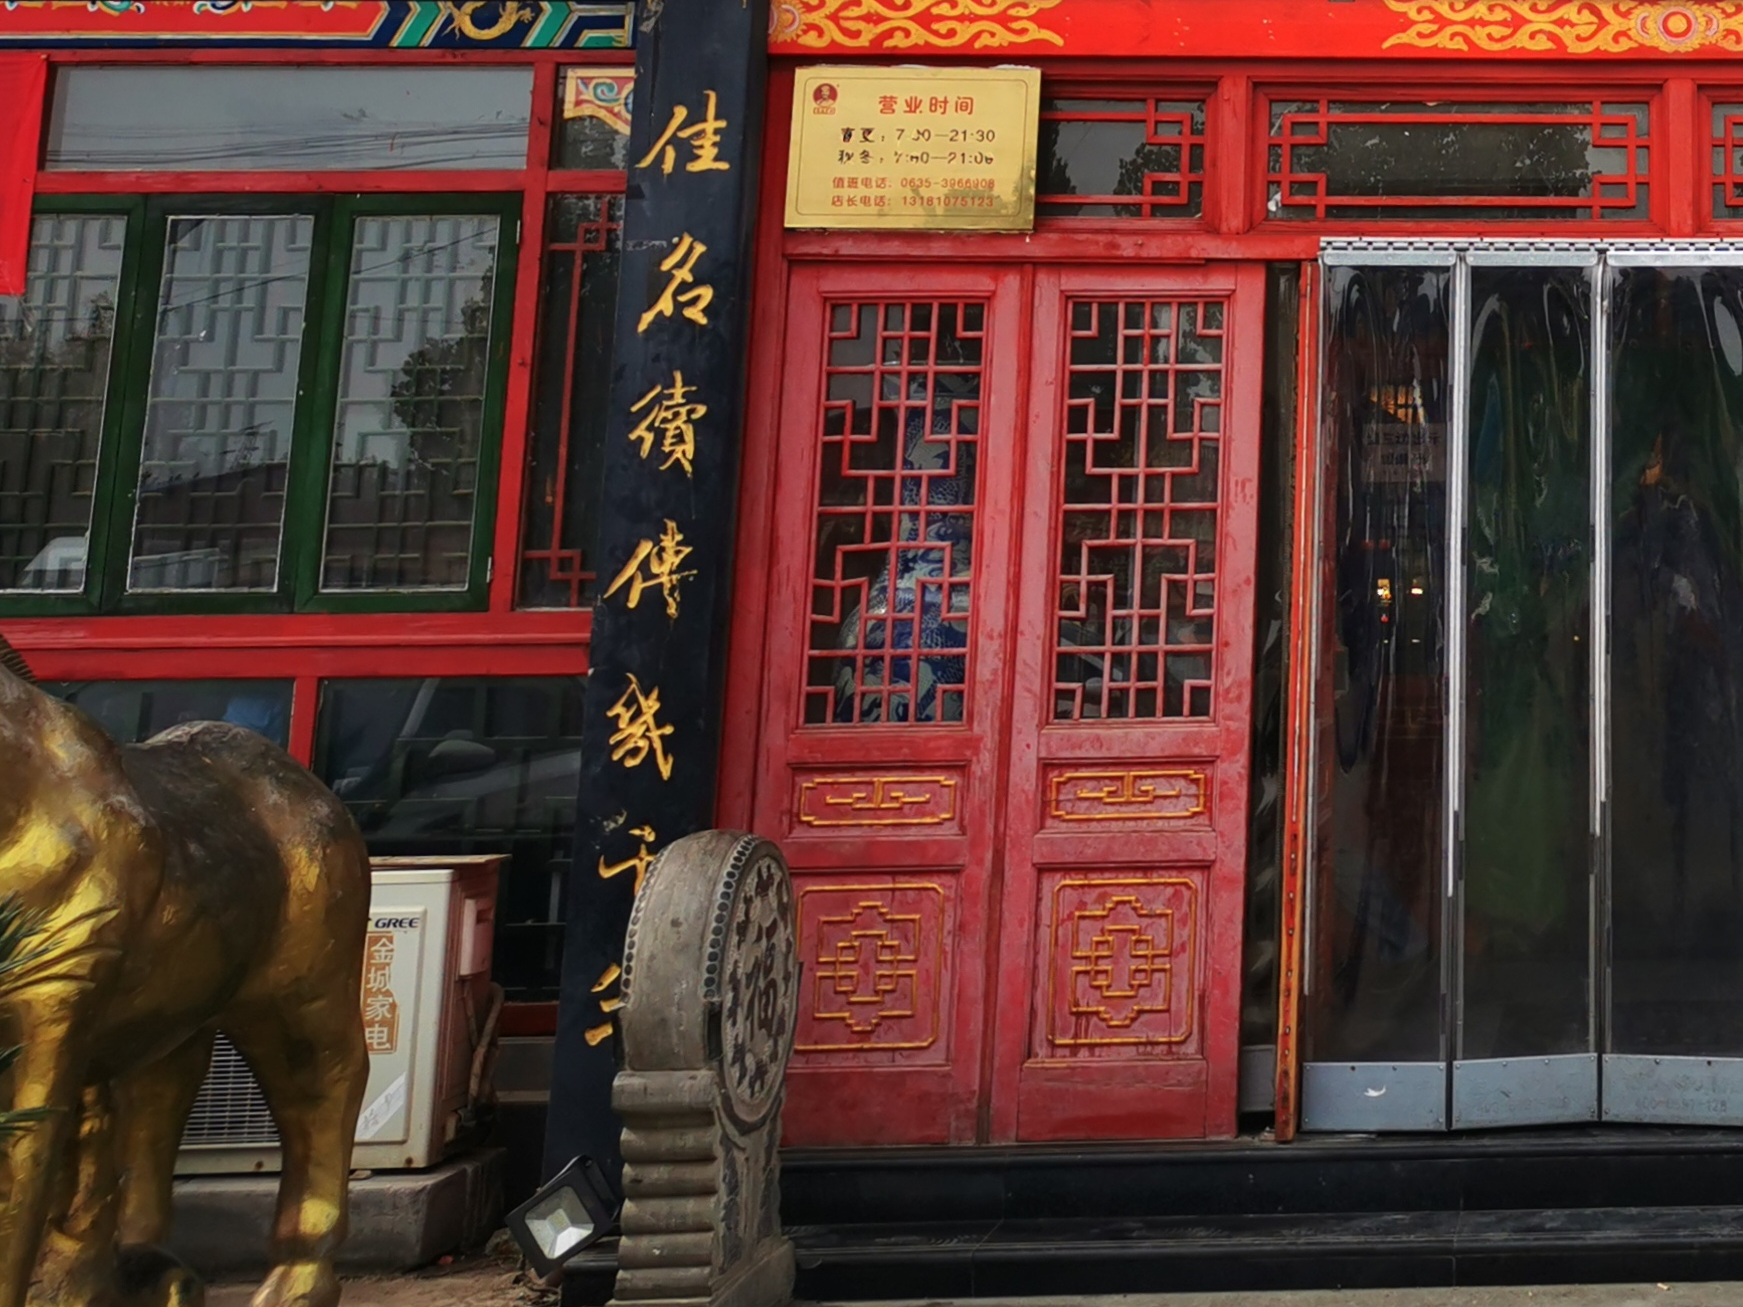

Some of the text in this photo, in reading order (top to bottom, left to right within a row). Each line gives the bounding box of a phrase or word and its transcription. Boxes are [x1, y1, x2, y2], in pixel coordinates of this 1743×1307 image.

[878, 95, 975, 115] 营业时间
[374, 917, 421, 930] GREE
[364, 937, 397, 1051] 金城家电
